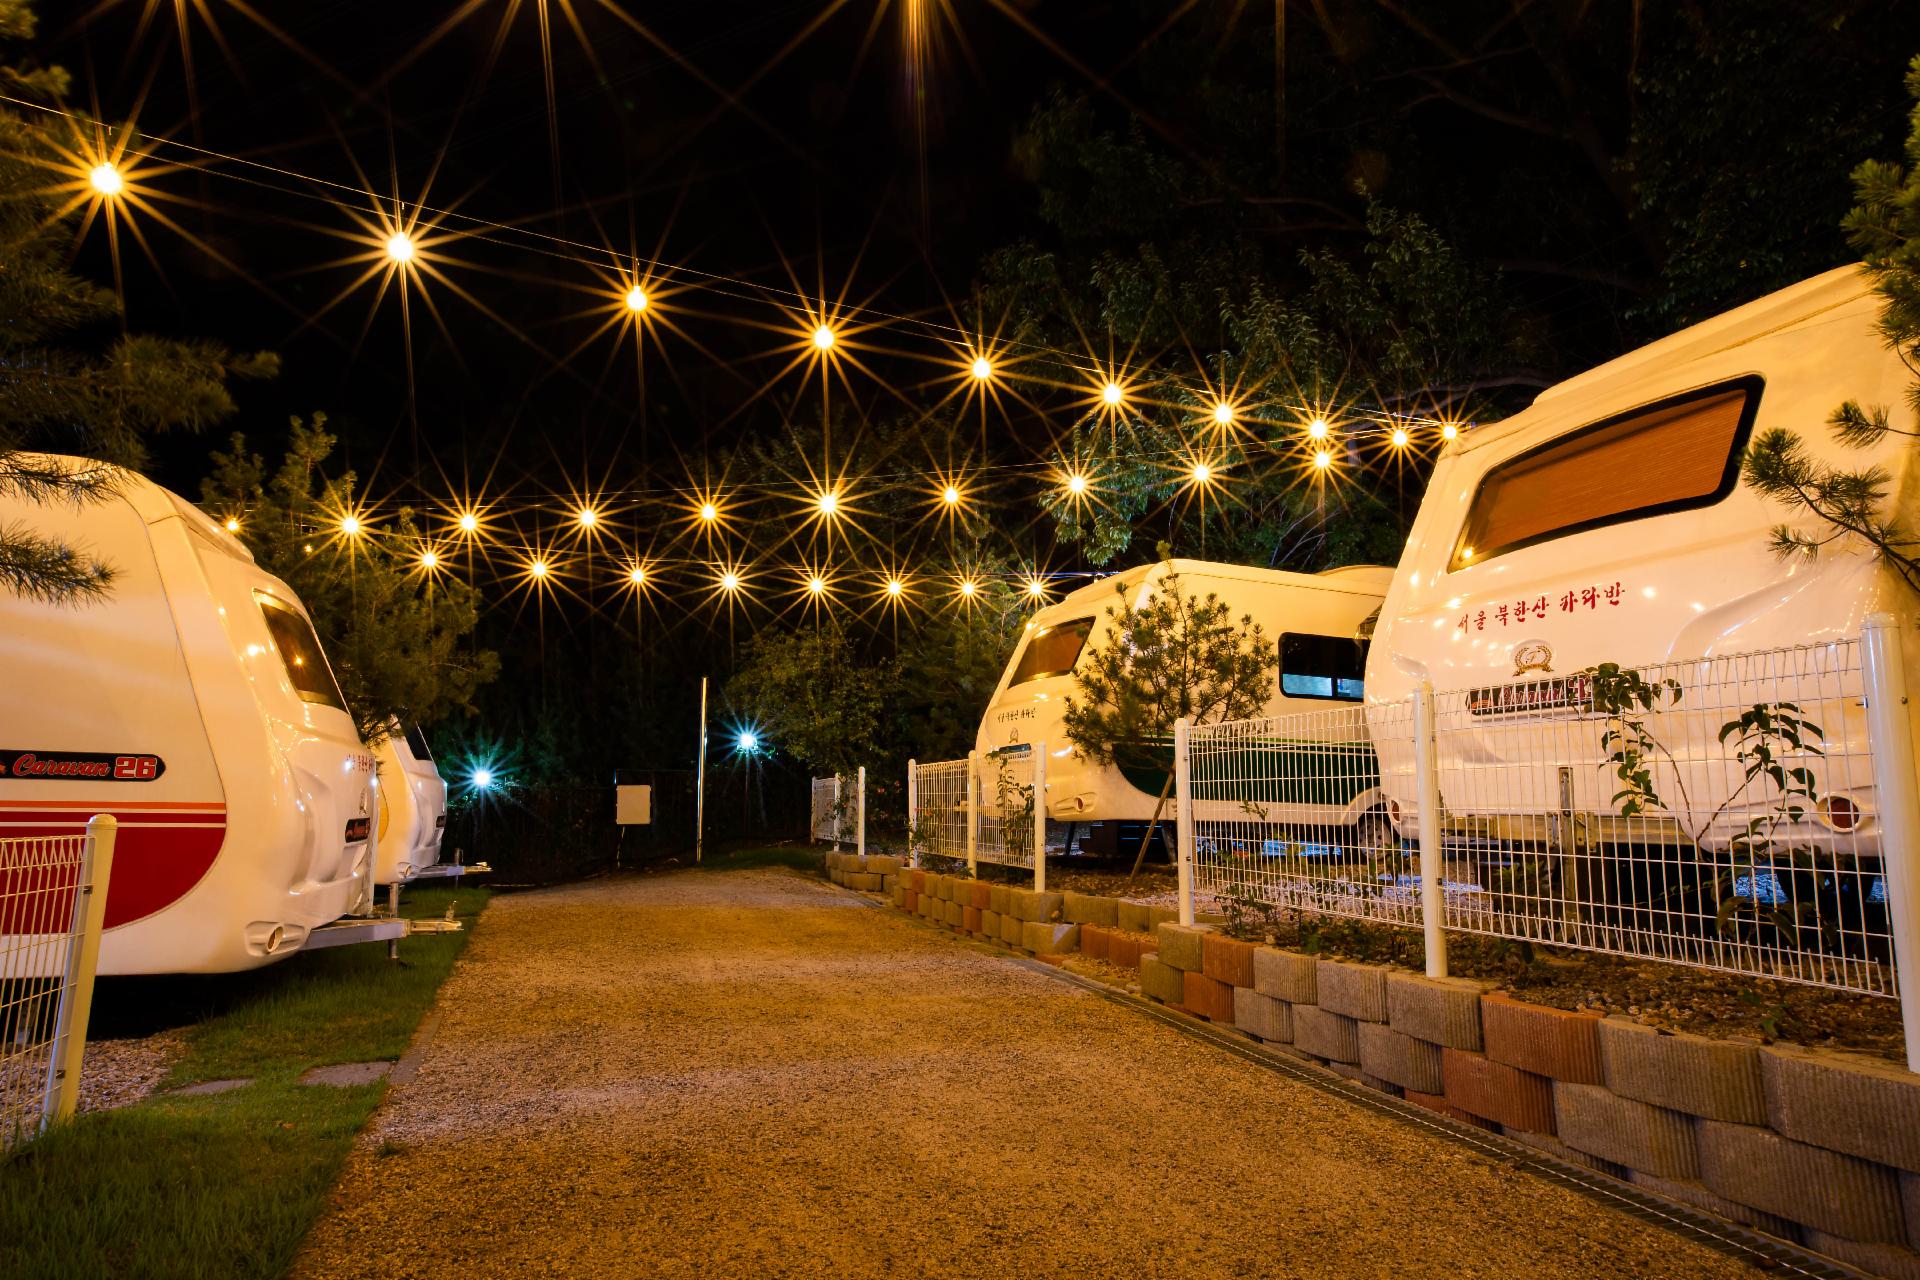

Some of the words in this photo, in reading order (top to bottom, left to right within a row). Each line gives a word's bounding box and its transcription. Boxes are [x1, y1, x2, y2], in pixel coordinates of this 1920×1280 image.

[1457, 610, 1487, 634] 서울
[1494, 595, 1550, 627] 북한산
[12, 753, 111, 777] Caravan
[113, 756, 158, 779] 26
